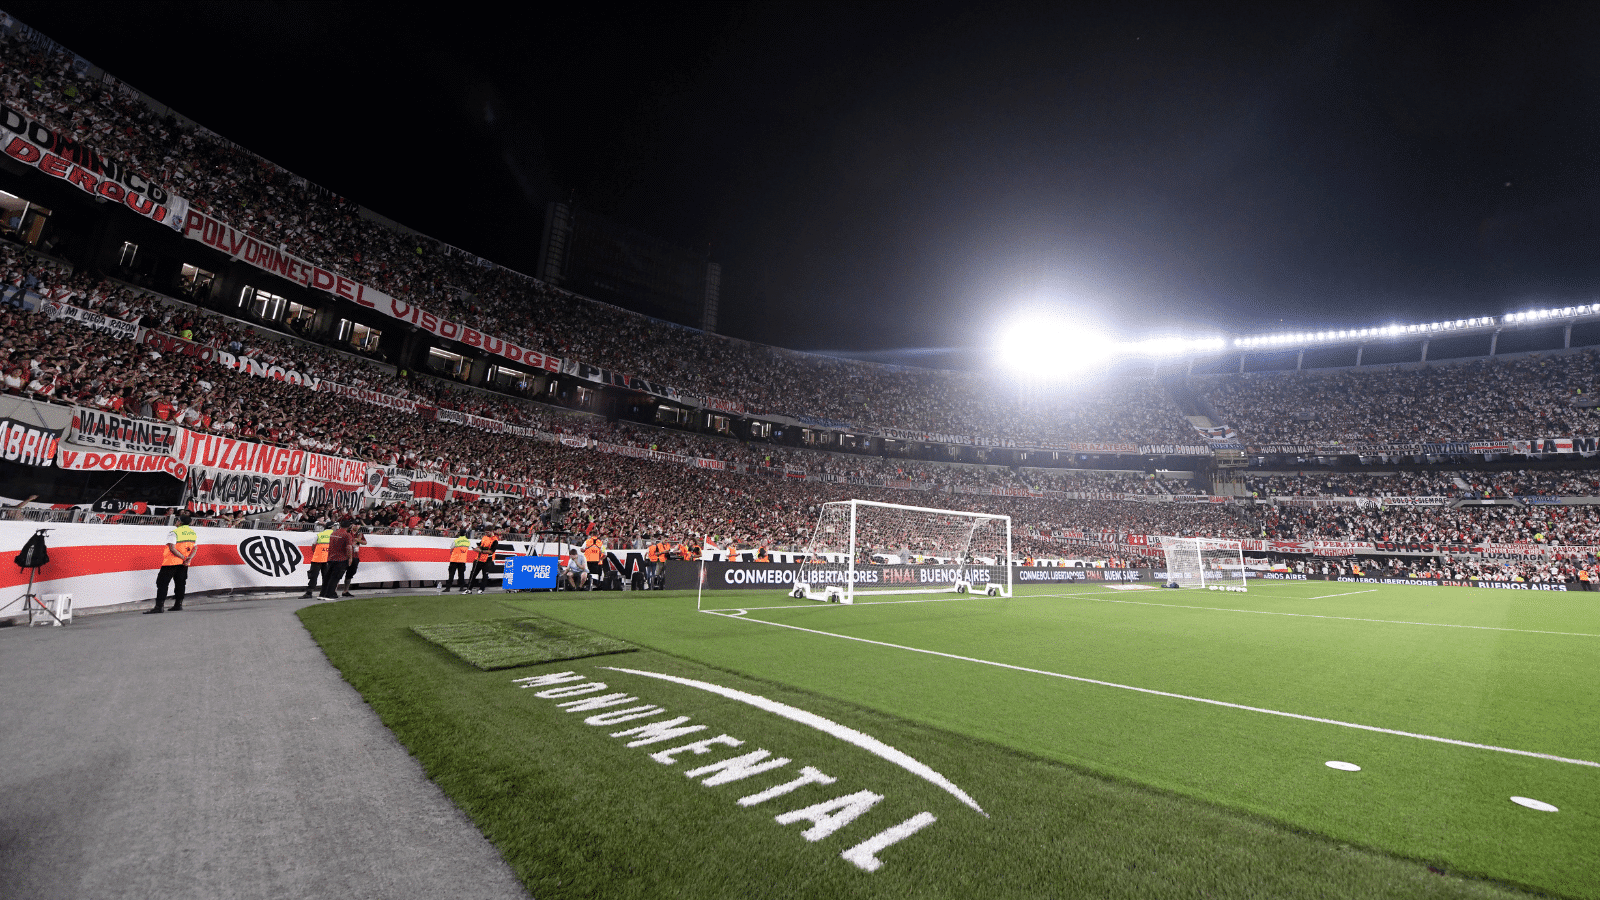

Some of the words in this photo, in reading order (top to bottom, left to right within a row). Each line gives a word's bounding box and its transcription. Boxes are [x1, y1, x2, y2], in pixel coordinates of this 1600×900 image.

[5, 136, 168, 222] DERQUI
[184, 209, 312, 286] POLVORINES
[313, 266, 375, 308] DEL
[391, 298, 458, 339] VISO
[65, 306, 78, 317] MI
[82, 311, 106, 325] CIEGA
[109, 319, 137, 333] RAZON
[461, 327, 560, 373] BUDGE
[80, 410, 171, 447] MARTINEZ
[77, 435, 96, 444] ES
[101, 438, 121, 448] DE
[126, 443, 170, 455] RIVER
[309, 453, 343, 481] PARQUE
[344, 461, 366, 483] CHAS
[210, 473, 283, 504] MADERO
[1374, 541, 1434, 553] LOMAS
[1481, 552, 1544, 561] LUZURIAGA
[521, 564, 551, 572] POWER
[724, 568, 798, 585] CONMEBOL
[802, 568, 878, 584] LIBERTADORES
[883, 568, 916, 584] FINAL
[920, 569, 962, 584] BUENOS
[965, 569, 991, 585] AIRES
[1020, 570, 1050, 581] CONMEBOL
[512, 671, 937, 872] MONUMENTAL
